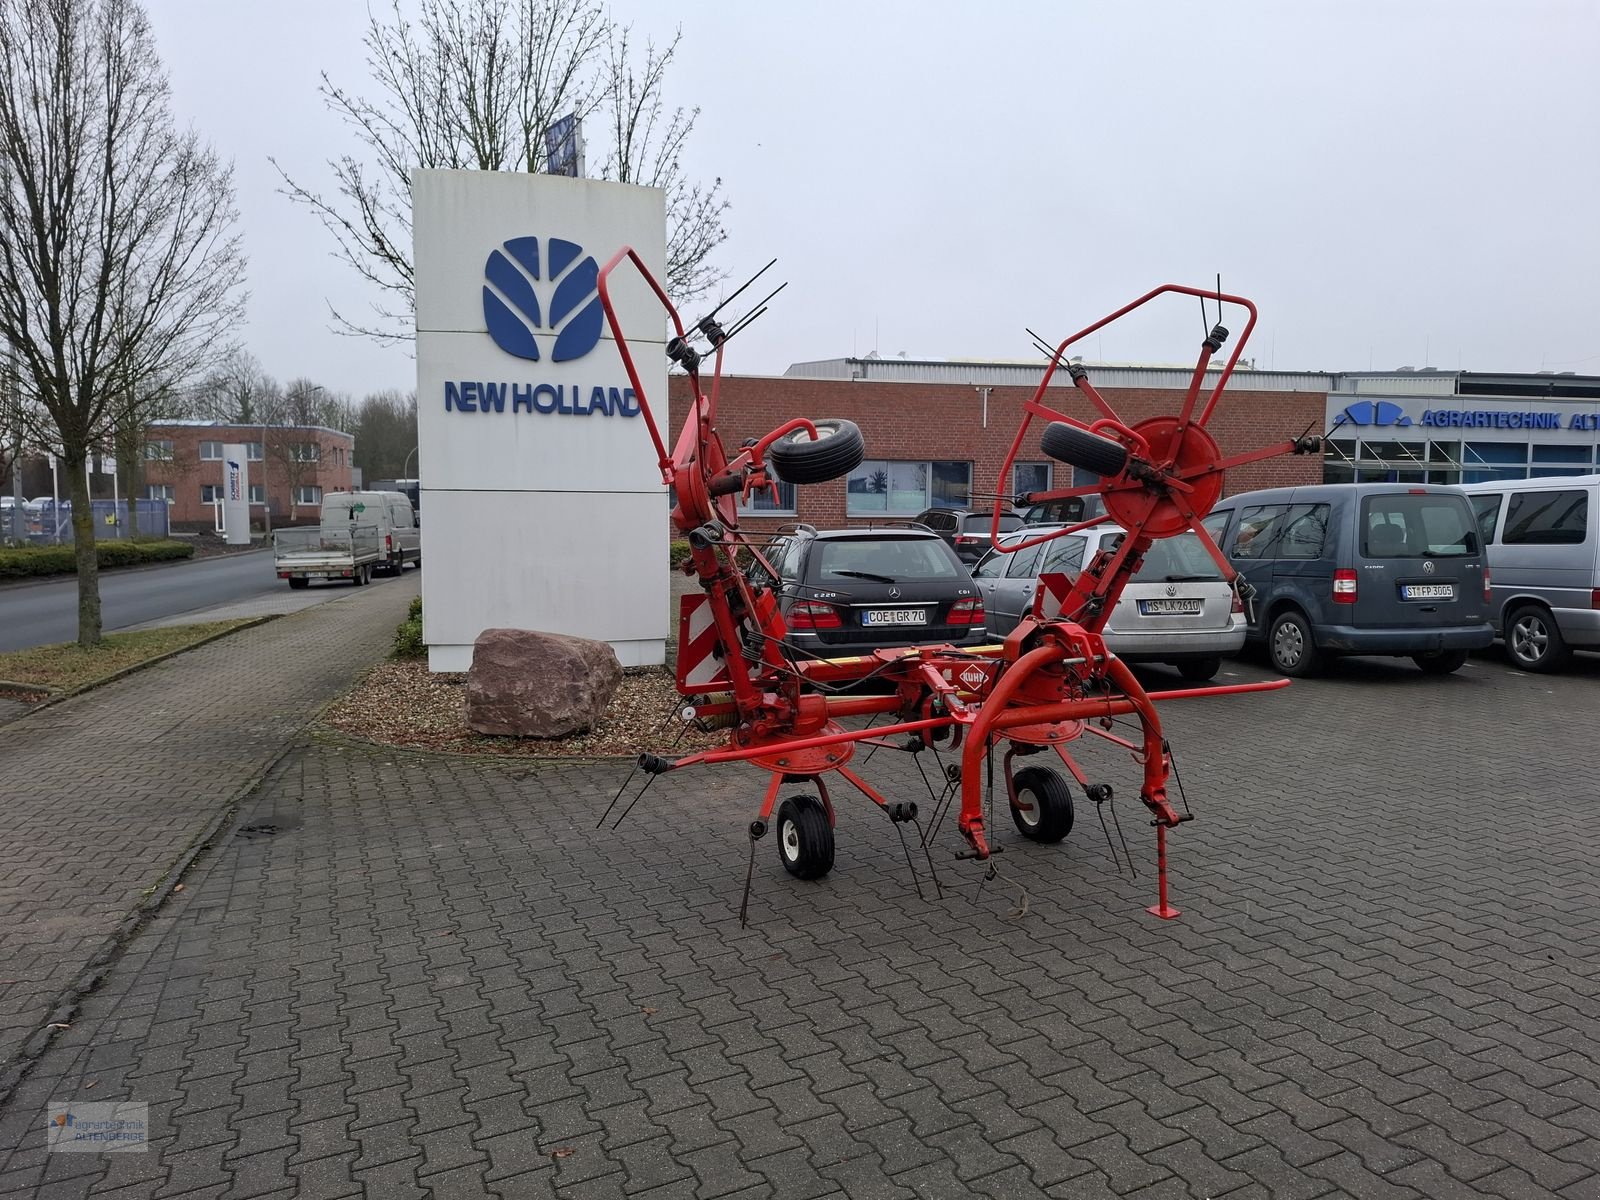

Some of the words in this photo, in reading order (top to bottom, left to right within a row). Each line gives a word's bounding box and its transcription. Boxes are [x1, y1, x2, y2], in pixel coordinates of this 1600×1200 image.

[444, 381, 507, 413] NEW
[512, 383, 642, 417] HOLLAND
[1422, 410, 1563, 429] AGRARTECHNIK
[1407, 587, 1416, 596] ST
[1422, 587, 1431, 596] FP
[1433, 586, 1452, 596] 3005
[1147, 601, 1159, 611] MS
[1165, 601, 1176, 611] LK
[1178, 600, 1199, 611] 2610
[869, 611, 890, 622] COE
[896, 611, 910, 622] GR
[912, 611, 925, 621] 70
